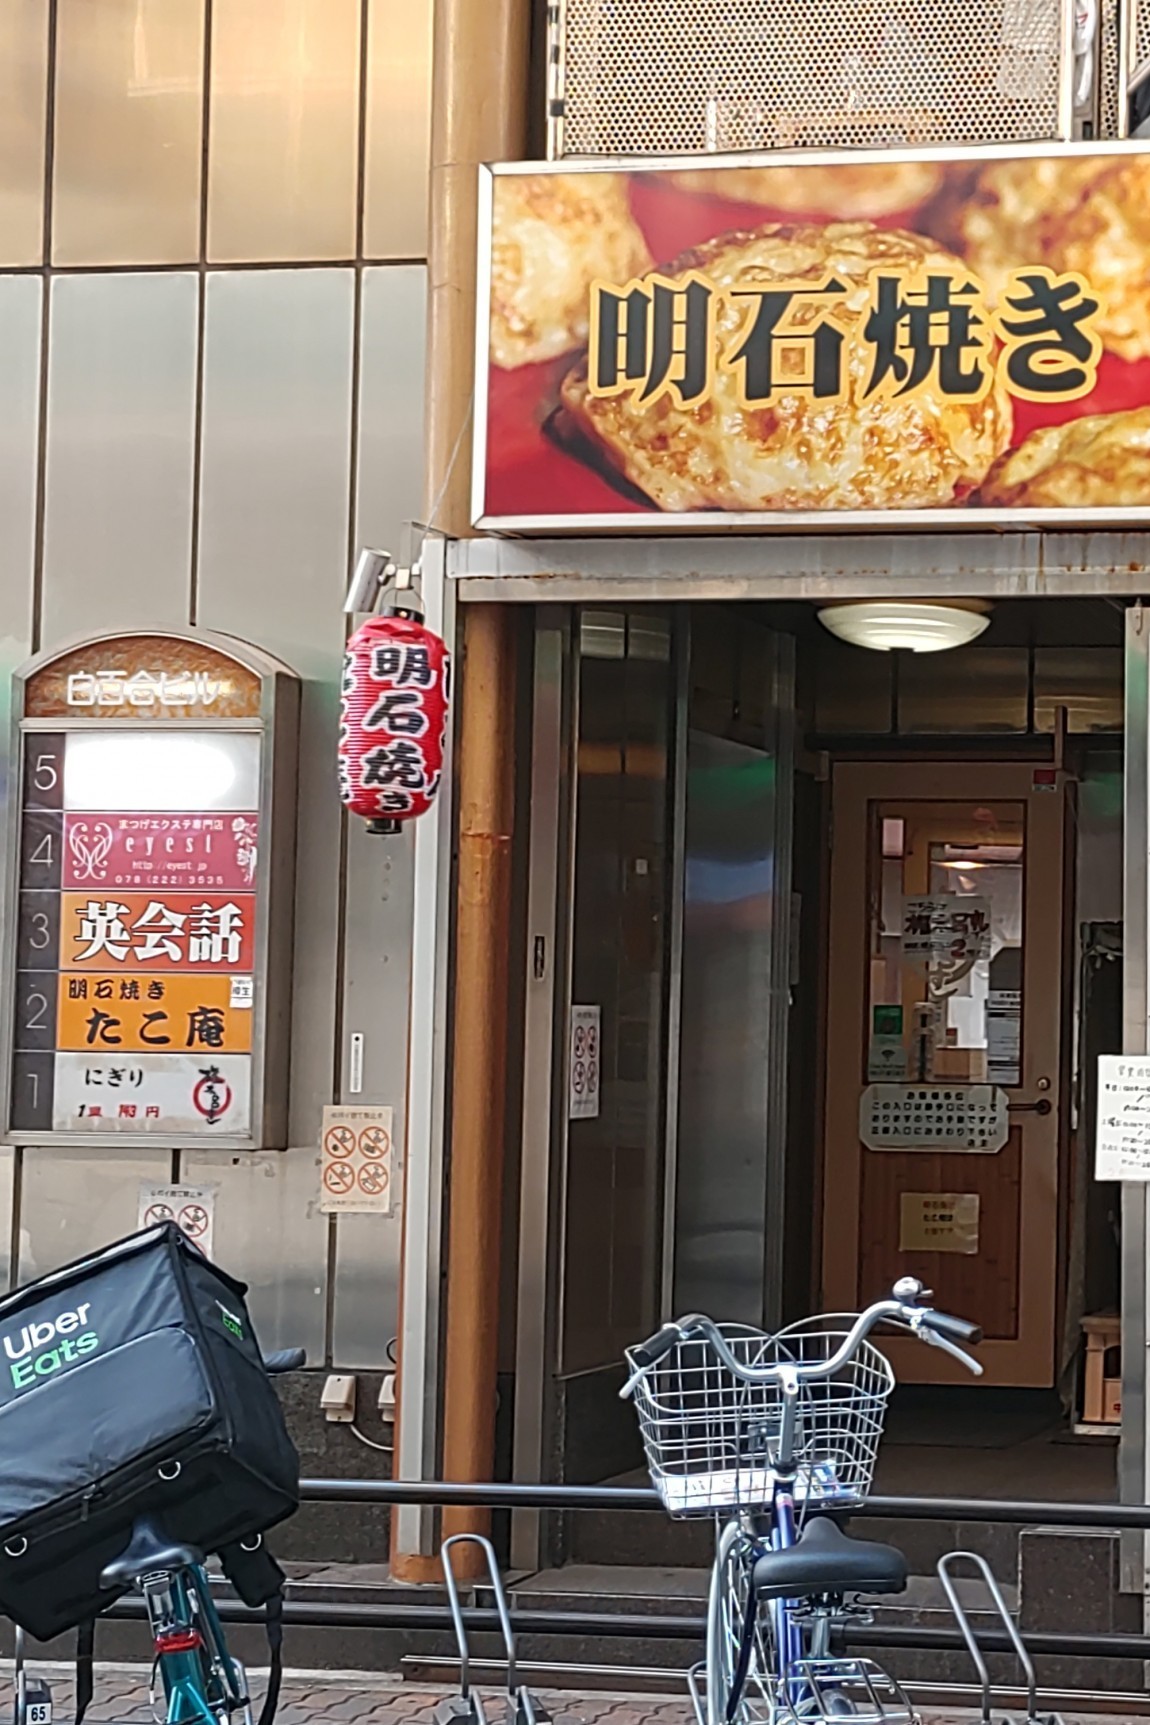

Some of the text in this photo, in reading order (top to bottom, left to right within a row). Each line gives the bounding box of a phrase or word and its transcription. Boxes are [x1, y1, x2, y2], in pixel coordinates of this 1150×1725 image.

[594, 271, 1101, 406] 明石焼き
[67, 670, 220, 706] 白百合ビル
[363, 646, 434, 812] 明石焼き
[34, 755, 57, 790] 5
[29, 834, 54, 868] 4
[29, 912, 49, 949] 3
[73, 900, 245, 963] 英会話
[69, 978, 165, 1001] 明石焼き
[26, 994, 47, 1029] 2
[86, 1006, 225, 1048] たこ庵
[27, 1074, 38, 1109] 1
[85, 1068, 144, 1087] にぎり
[3, 1302, 91, 1360] Uber
[9, 1329, 99, 1390] Eats
[30, 1706, 46, 1722] 65
